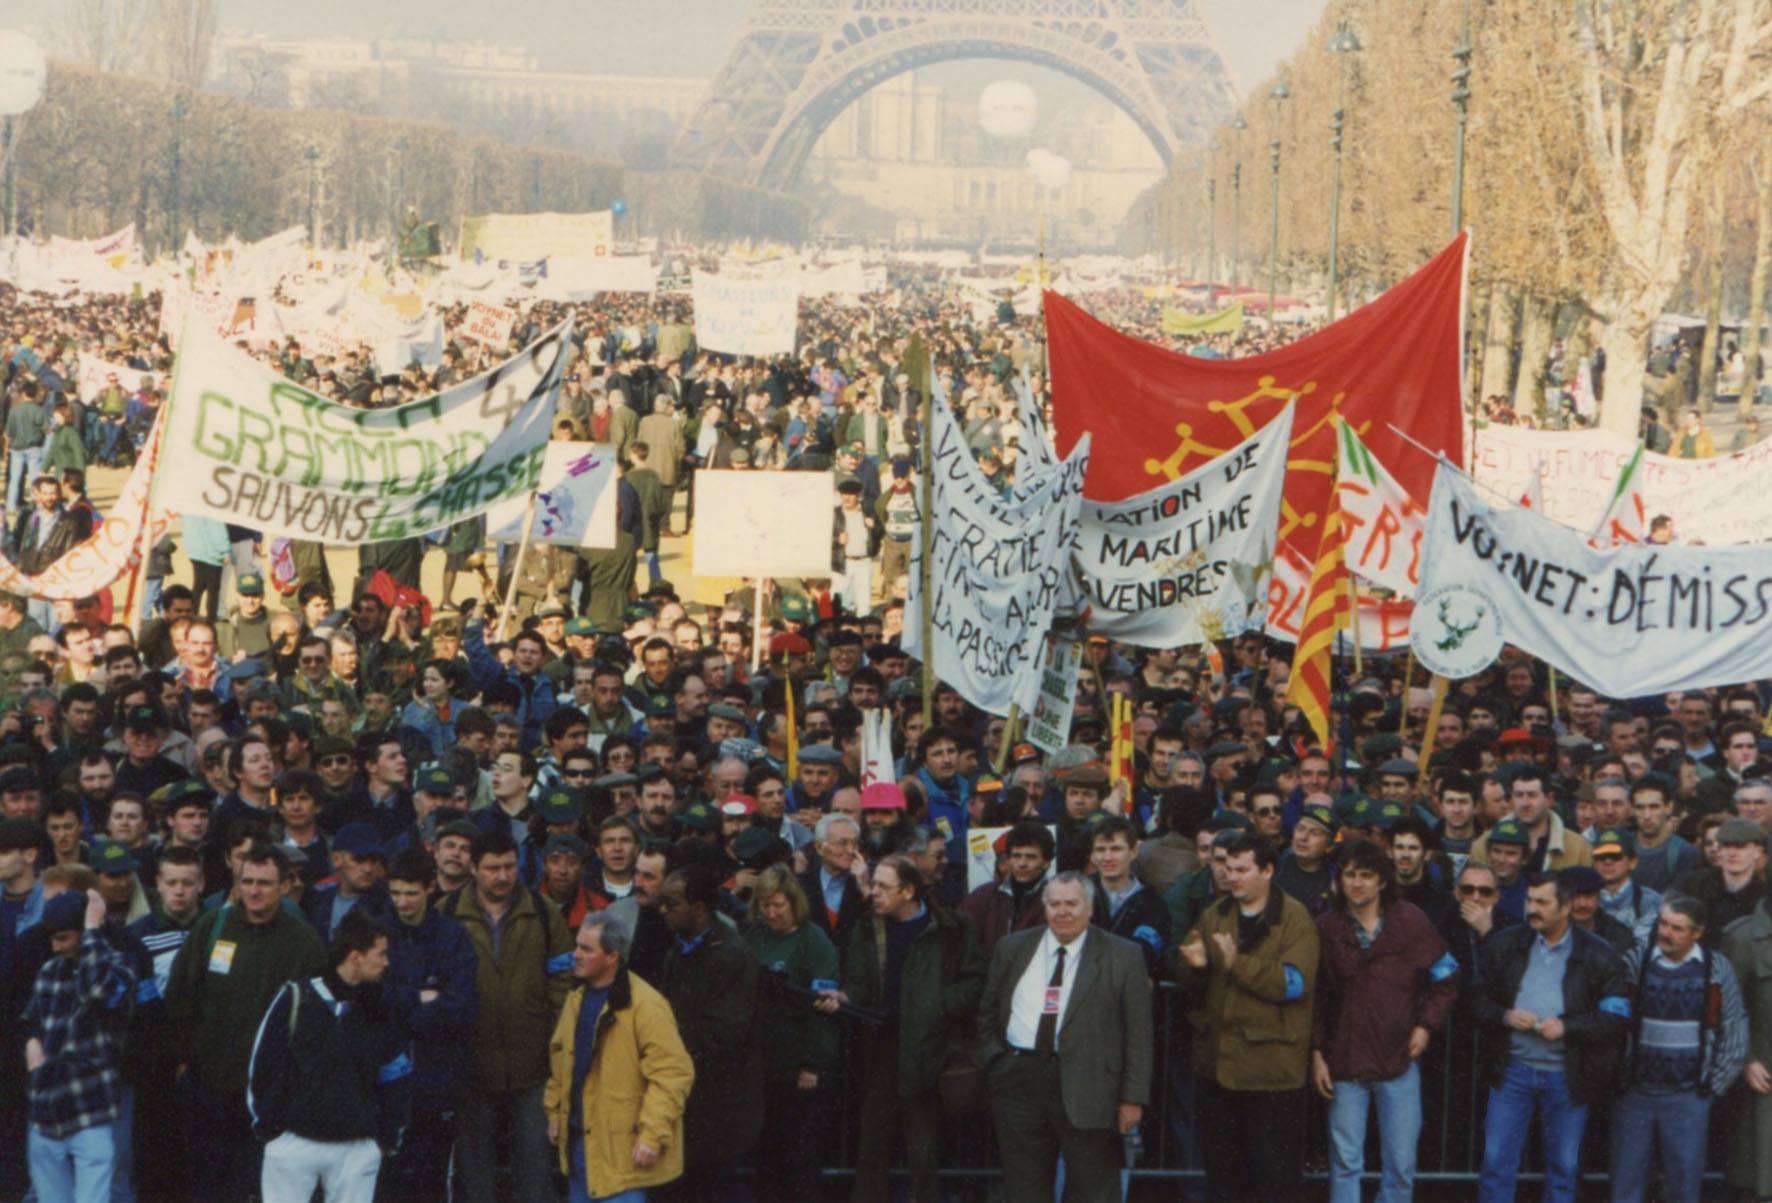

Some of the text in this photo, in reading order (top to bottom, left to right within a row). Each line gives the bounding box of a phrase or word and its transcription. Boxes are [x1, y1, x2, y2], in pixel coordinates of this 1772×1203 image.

[1224, 441, 1271, 485] DE
[202, 465, 375, 543] SAUVONS
[1095, 560, 1229, 614] VENDRES
